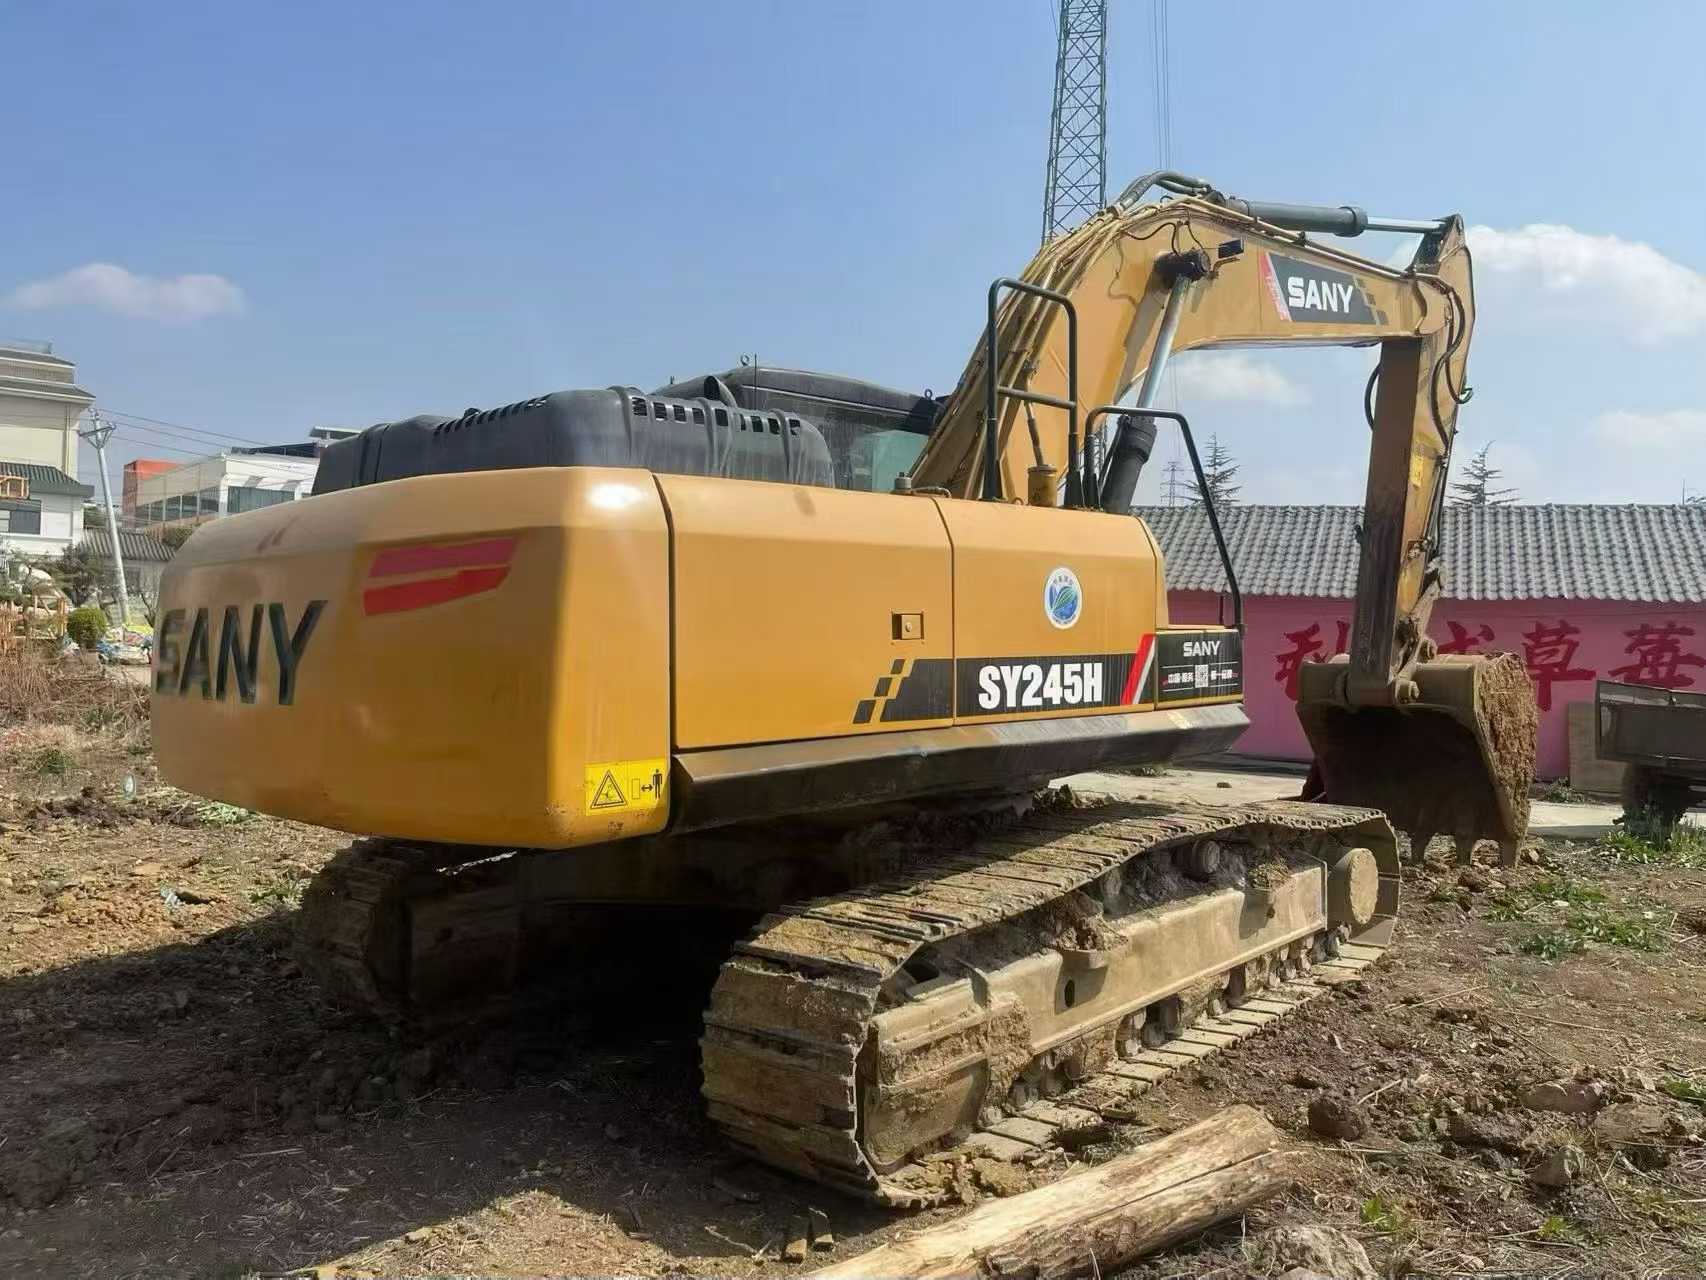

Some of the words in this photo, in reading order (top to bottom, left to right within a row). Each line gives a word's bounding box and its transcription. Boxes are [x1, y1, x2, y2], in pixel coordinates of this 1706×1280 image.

[1287, 276, 1354, 314] SANY
[156, 600, 328, 705] SANY
[1183, 640, 1221, 657] SANY
[978, 662, 1103, 710] SY245H
